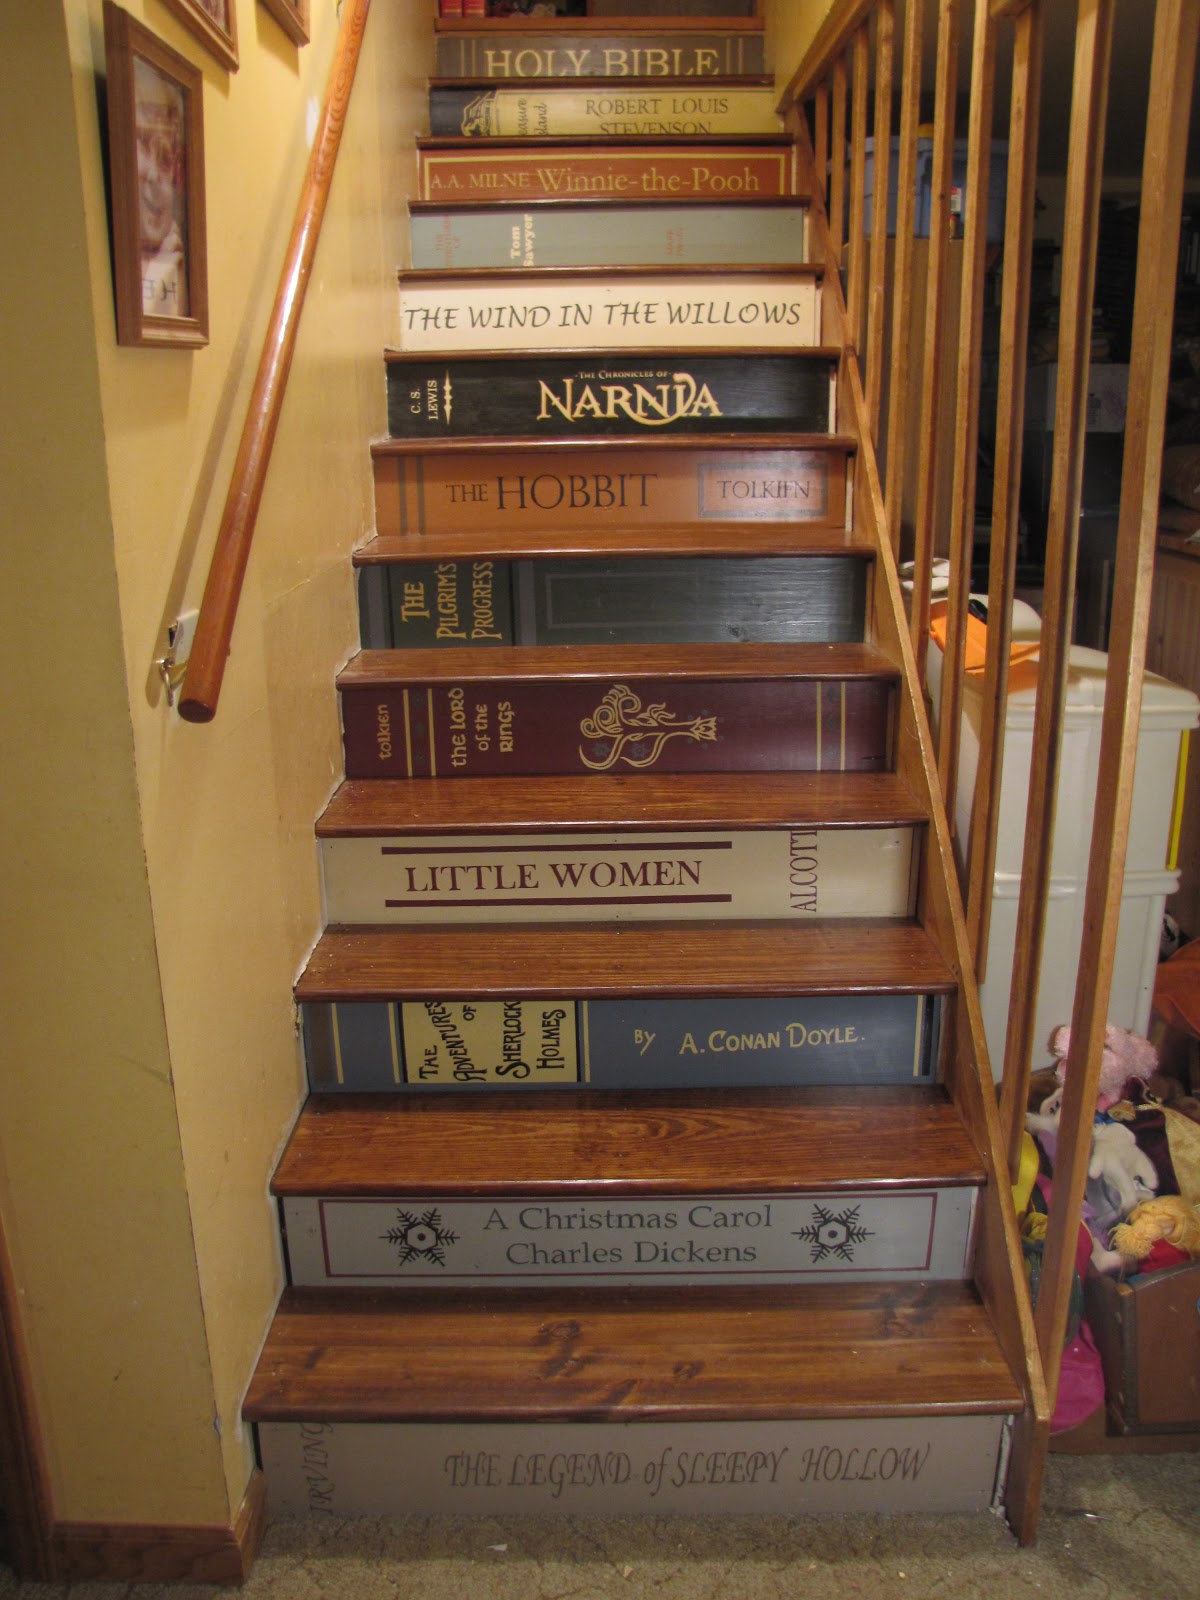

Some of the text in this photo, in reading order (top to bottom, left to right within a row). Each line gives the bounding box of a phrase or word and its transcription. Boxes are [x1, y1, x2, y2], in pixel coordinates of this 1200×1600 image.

[484, 48, 720, 77] HOLY BIBLE
[517, 97, 529, 135] easure
[584, 98, 729, 117] ROBERT LOUIS
[599, 121, 712, 135] STEVENSON
[469, 172, 531, 188] MILNE
[536, 167, 760, 193] Winnie-the-Pooh
[510, 226, 521, 259] Tom
[523, 213, 536, 267] Sawyer
[404, 300, 802, 331] THE WIND IN THE WILLOWS
[427, 379, 439, 421] LEWIS
[536, 372, 724, 426] NARNIA
[445, 472, 659, 511] THE HOBBIT
[716, 478, 812, 500] TOLKIEN
[401, 582, 431, 623] THE
[471, 562, 502, 640] PROGRESS
[474, 704, 491, 752] of the
[451, 734, 467, 767] the
[405, 860, 703, 893] LITTLE WOMEN
[789, 830, 818, 913] ALCOTT
[424, 1001, 487, 1081] ADVENTURES OF
[495, 1001, 530, 1079] SHERLOCK
[536, 1009, 567, 1069] HOLMES
[634, 1029, 656, 1056] BY
[708, 1030, 780, 1052] CONAN
[418, 1045, 439, 1079] THE
[484, 1204, 773, 1231] A Christmas Carol
[505, 1238, 758, 1266] Charles Dickens
[444, 1442, 931, 1498] THE LEGEND of SLEEPY HOLLOW
